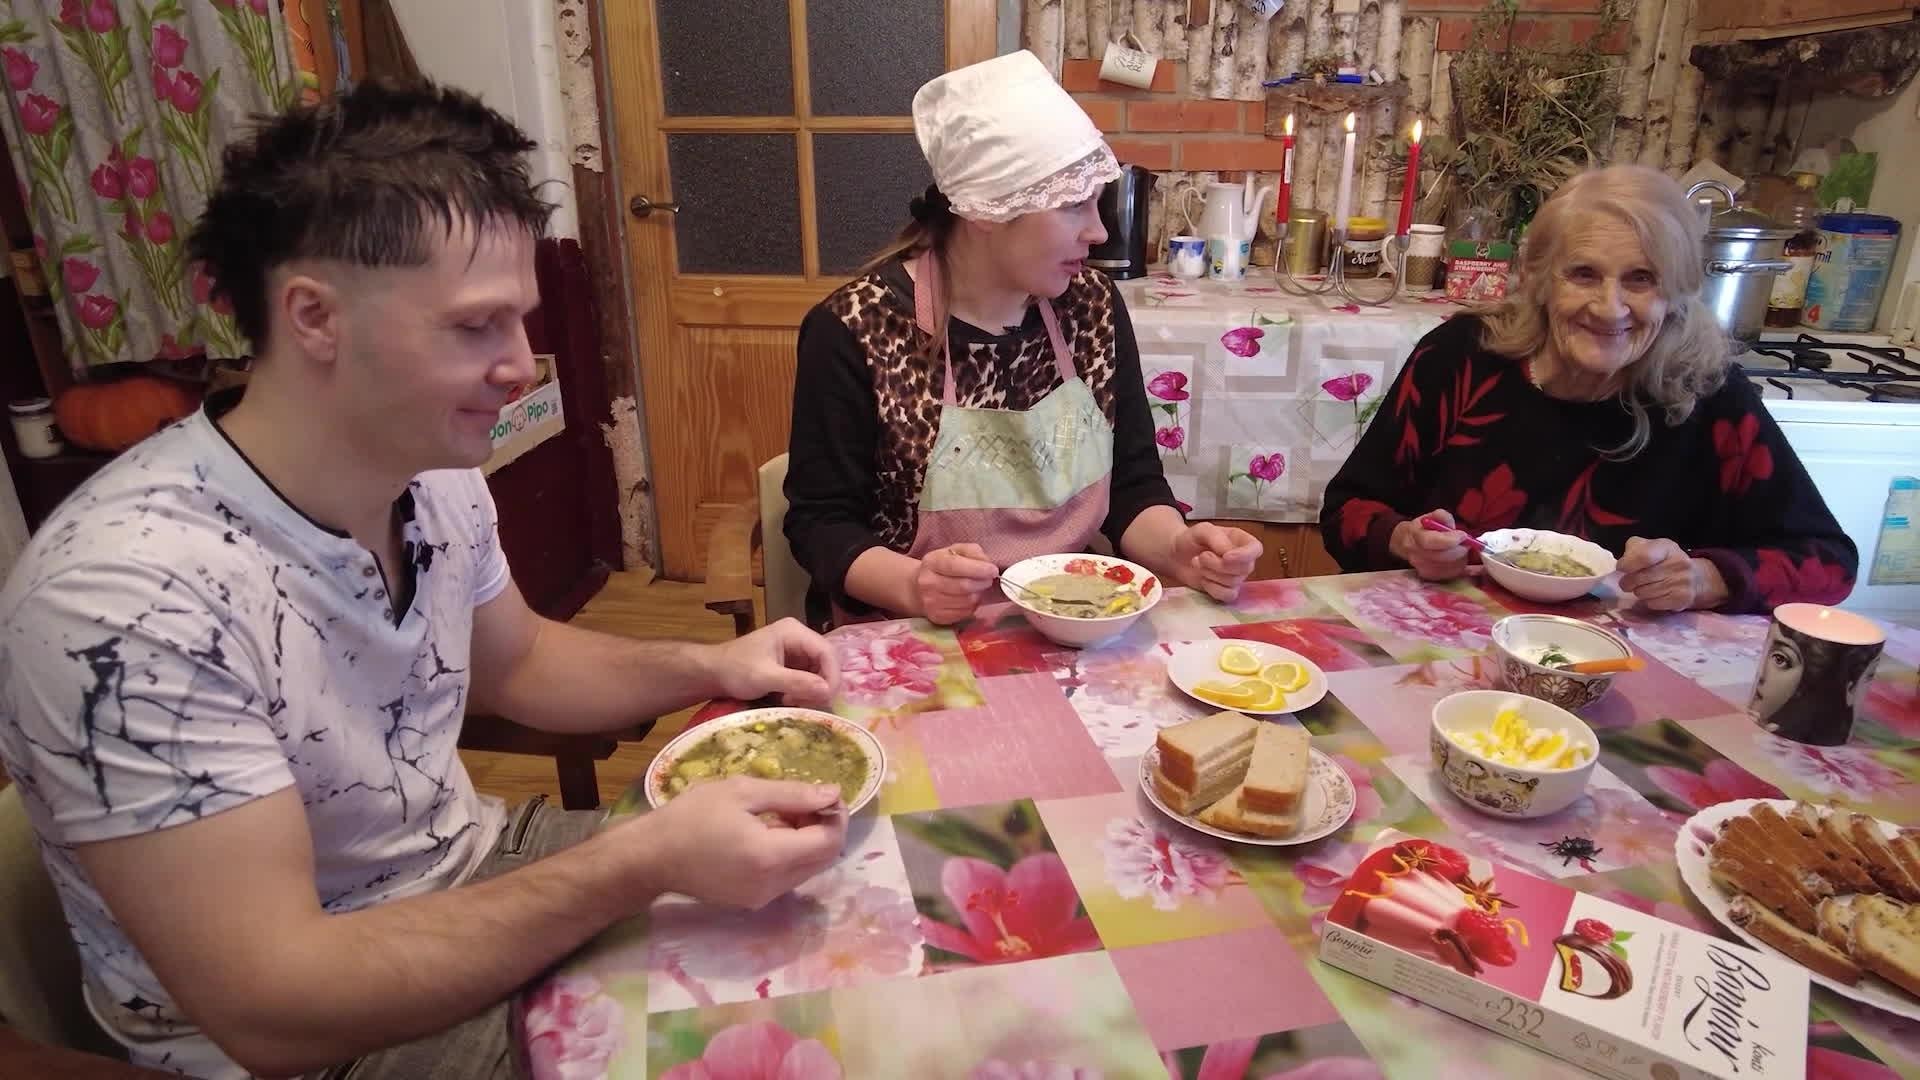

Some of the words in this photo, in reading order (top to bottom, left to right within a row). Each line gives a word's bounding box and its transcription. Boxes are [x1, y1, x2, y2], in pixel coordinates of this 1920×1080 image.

[1453, 265, 1497, 273] STRAWBERRY
[1807, 304, 1822, 322] 4
[1683, 944, 1771, 1073] Bonjour
[1751, 1041, 1776, 1074] Konti
